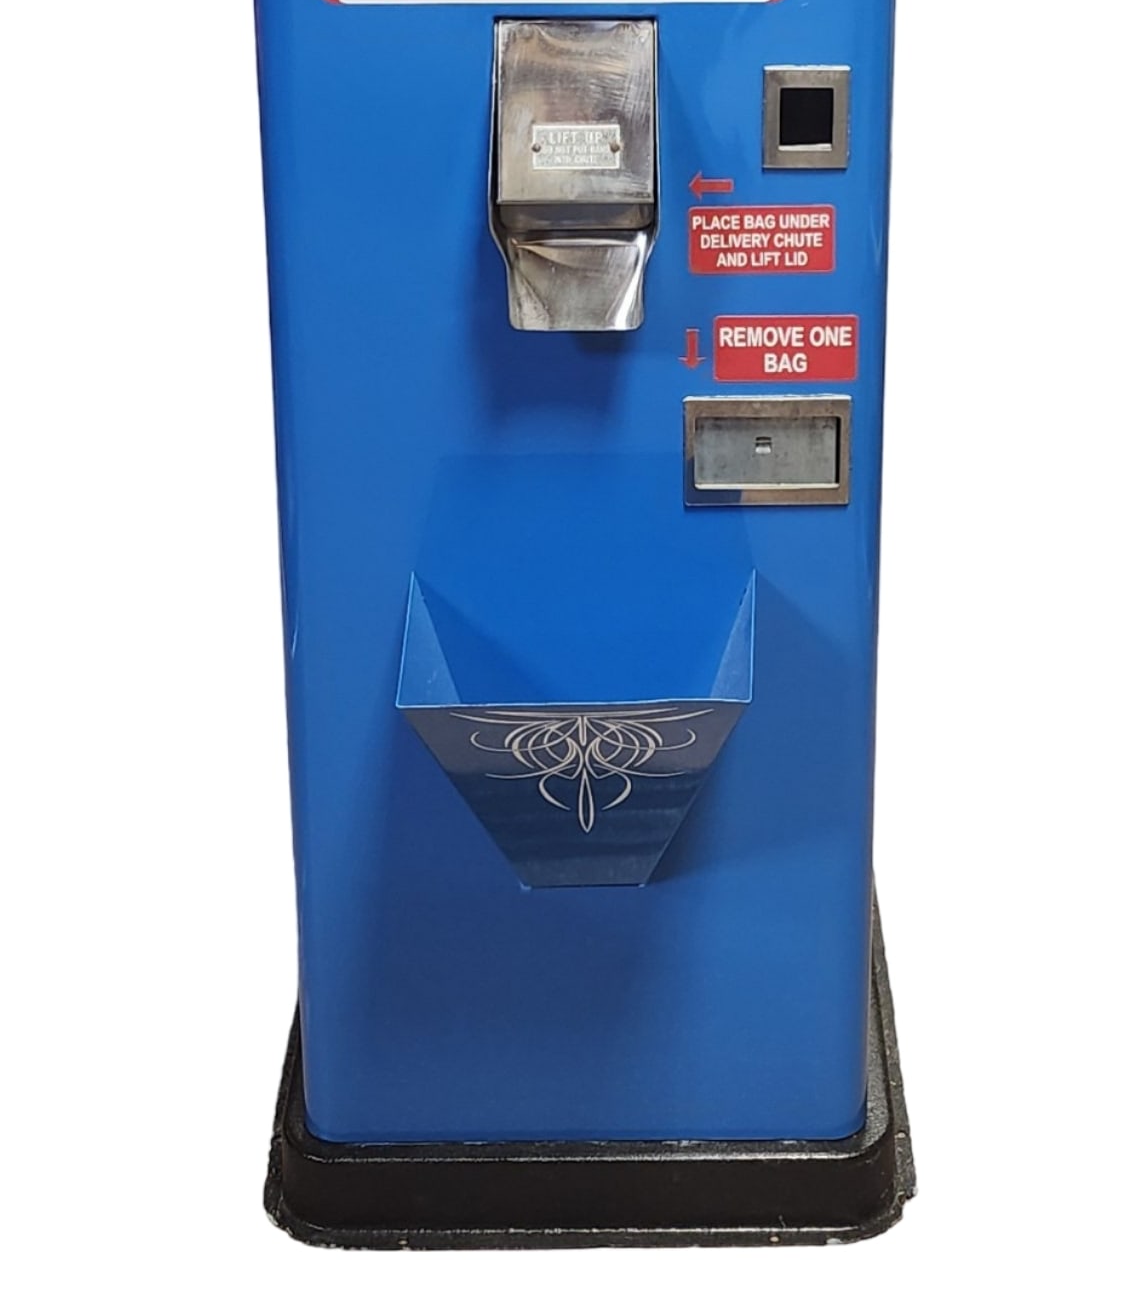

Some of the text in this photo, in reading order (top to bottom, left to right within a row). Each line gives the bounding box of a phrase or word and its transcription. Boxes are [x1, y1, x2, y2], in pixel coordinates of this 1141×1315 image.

[549, 132, 603, 143] LIFT UP
[693, 214, 829, 229] PLACE BAG UNDER
[701, 233, 822, 248] DELIVERY CHUTE
[717, 252, 807, 266] AND LIFT LID
[720, 326, 851, 347] REMOVE ONE
[765, 353, 807, 372] BAG
